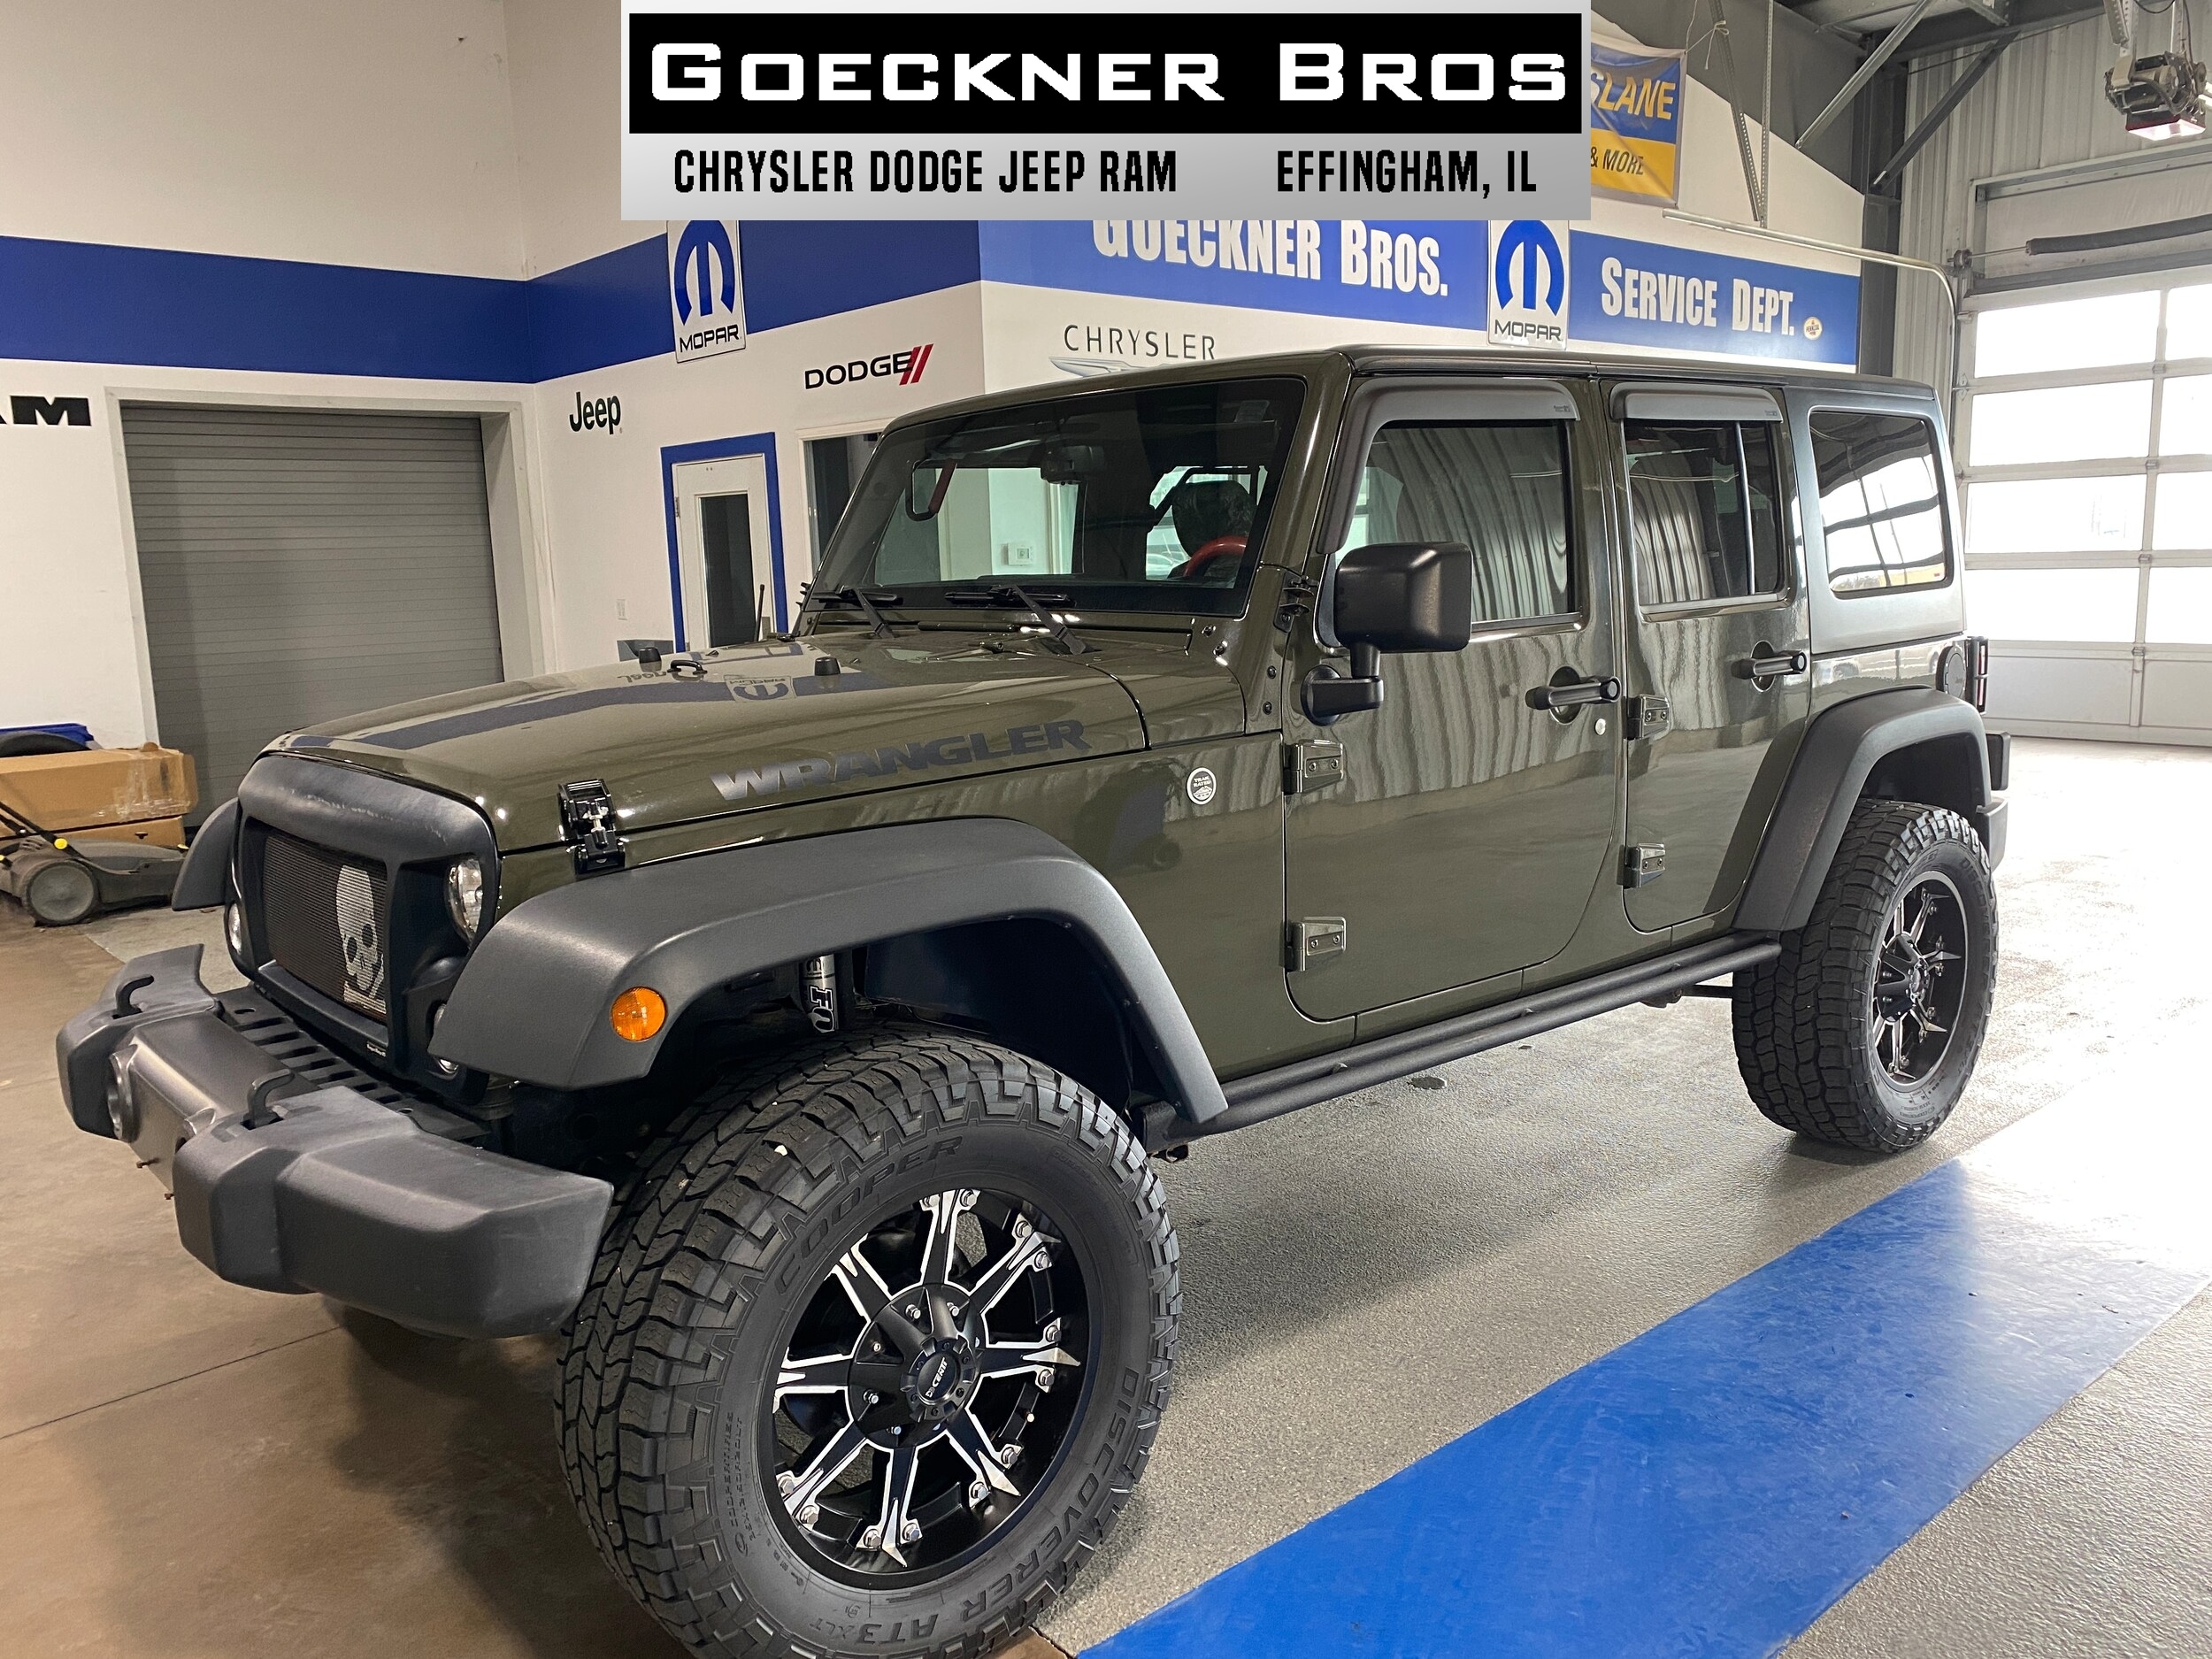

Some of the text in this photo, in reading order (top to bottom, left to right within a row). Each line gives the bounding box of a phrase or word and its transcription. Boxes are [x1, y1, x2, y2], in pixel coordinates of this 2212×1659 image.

[1602, 149, 1644, 175] MORE
[1601, 257, 1795, 336] SERVICE DEPT.
[679, 324, 740, 353] MOPAR
[1064, 324, 1216, 360] CHRYSLER
[1494, 319, 1561, 342] MOPAR
[804, 352, 914, 389] DODGE
[569, 391, 621, 434] Jeep
[709, 719, 1093, 801] WRANGLER
[774, 1135, 964, 1294] COOPER
[809, 1366, 1139, 1645] DISCOVERER AT3 XLT
